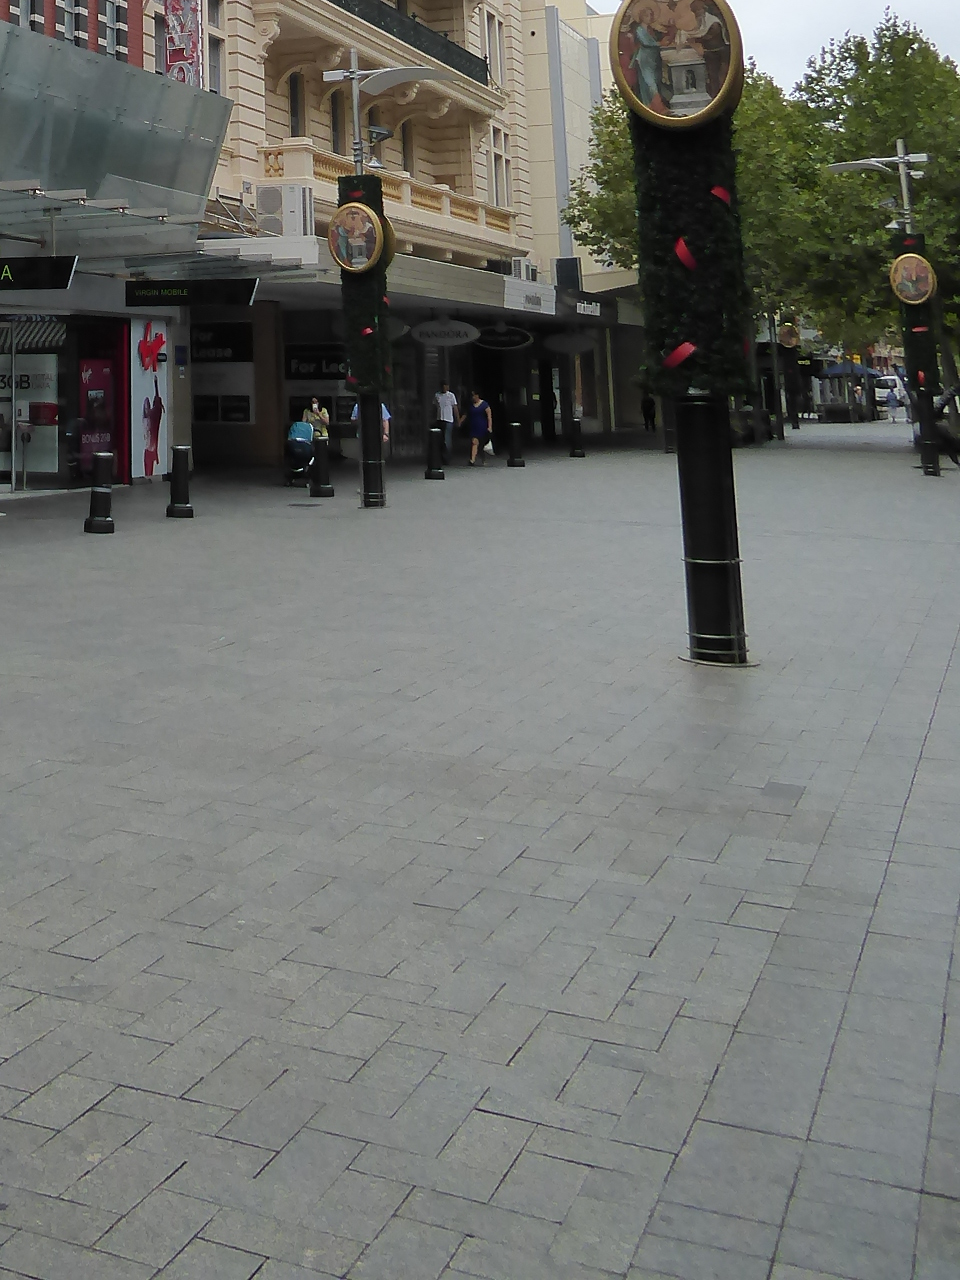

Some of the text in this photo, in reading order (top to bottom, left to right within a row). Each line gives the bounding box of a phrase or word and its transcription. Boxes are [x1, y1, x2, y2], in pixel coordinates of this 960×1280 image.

[161, 288, 188, 296] MOBILE
[419, 330, 469, 339] PANDORA
[192, 347, 233, 358] Lease
[291, 359, 316, 372] For
